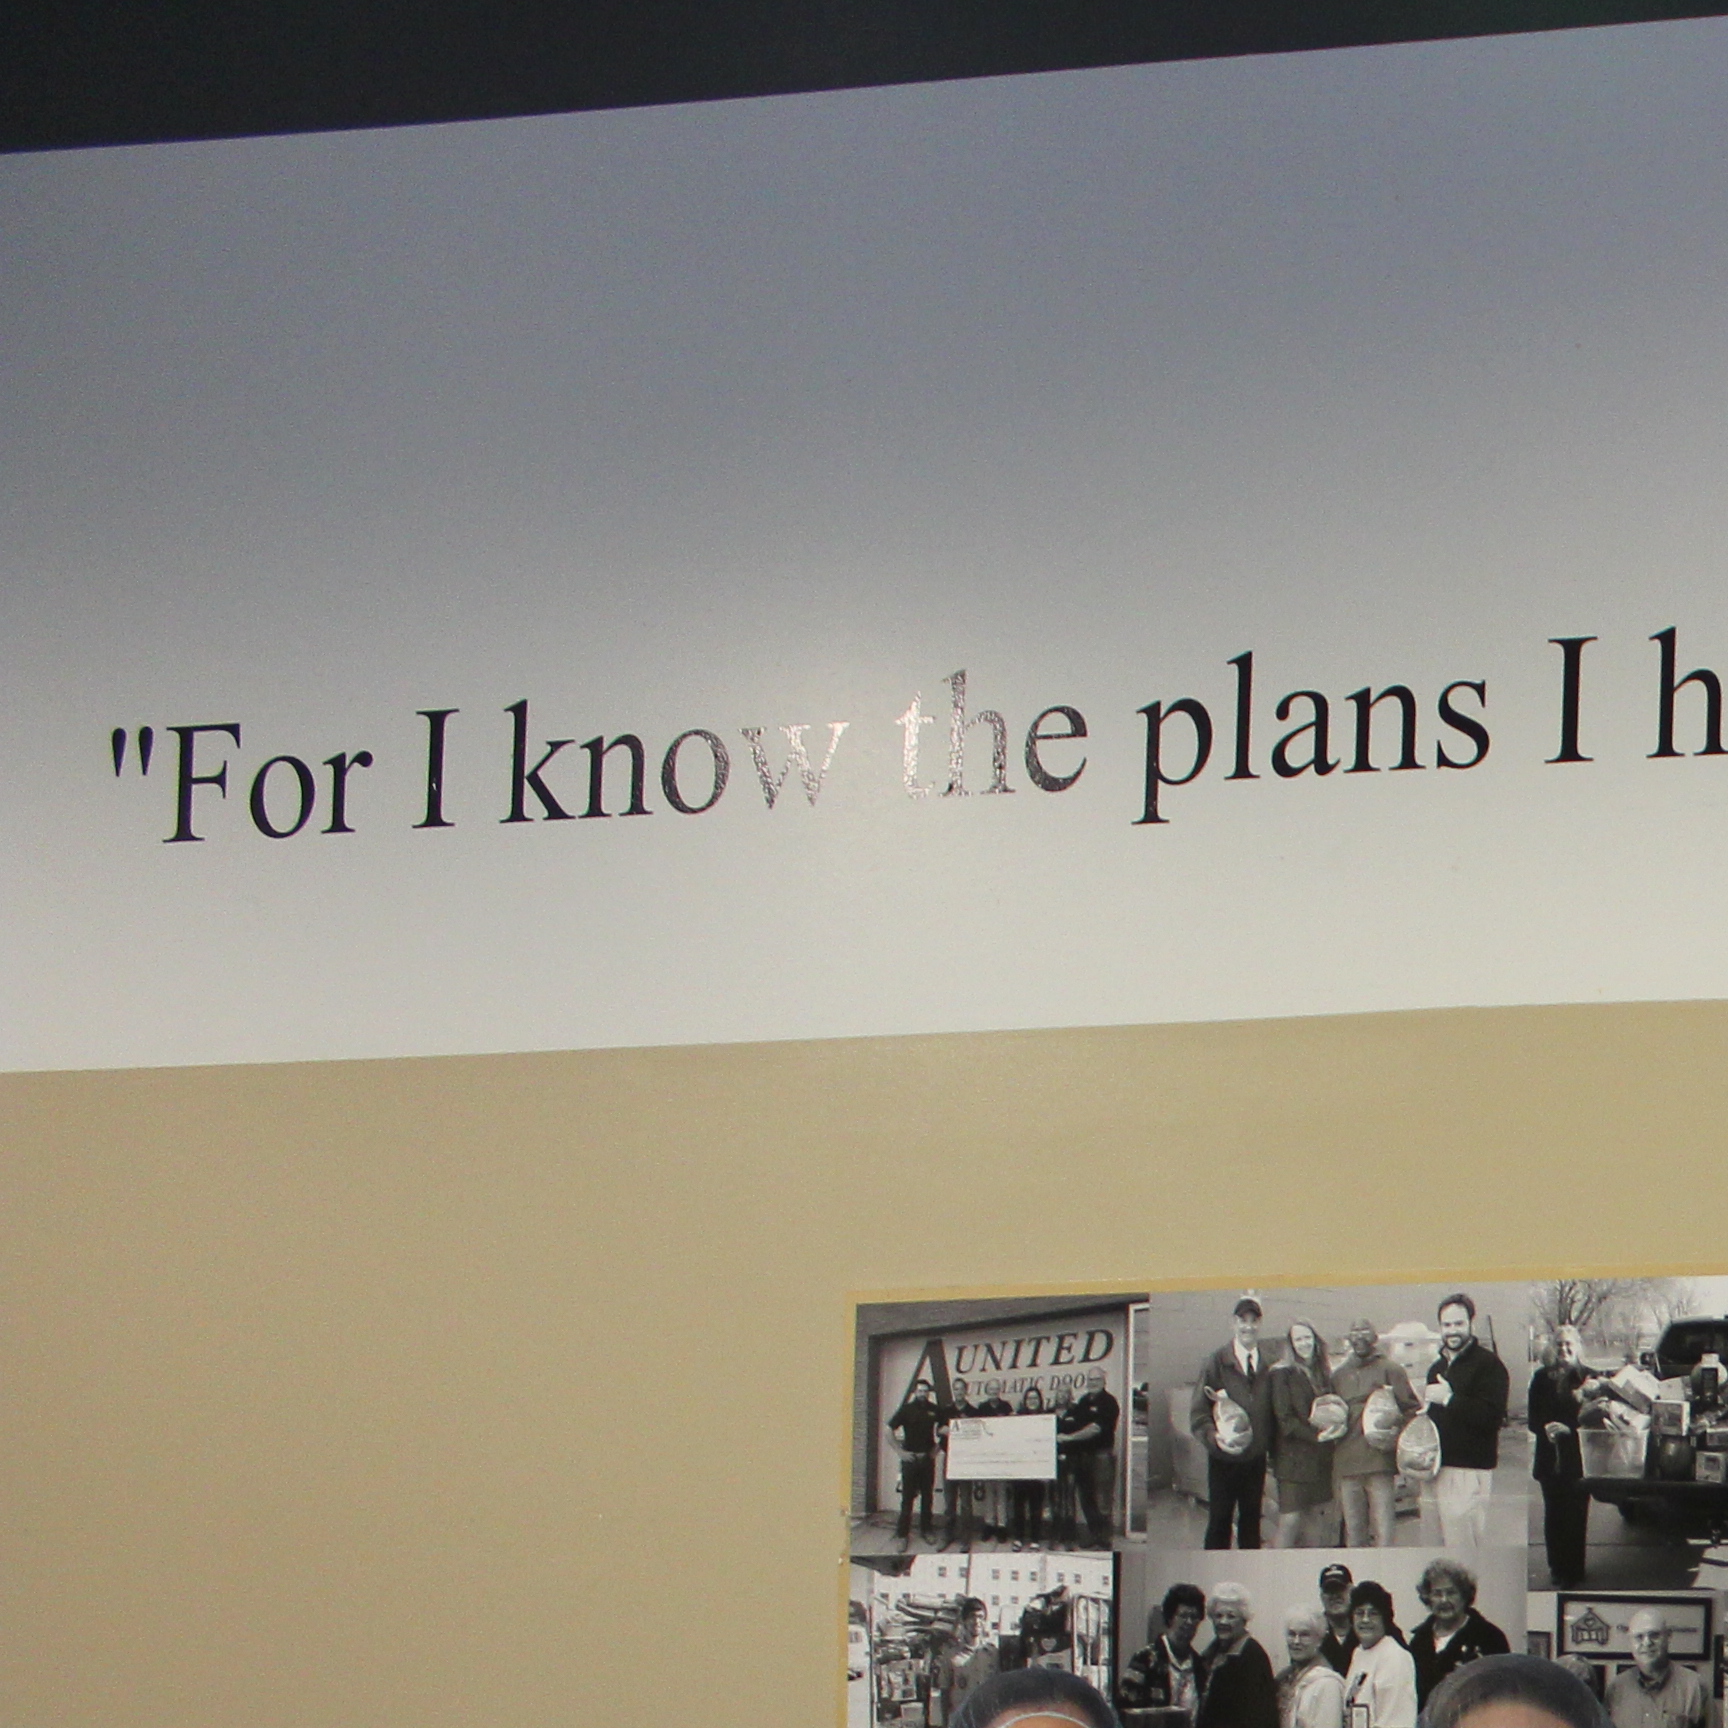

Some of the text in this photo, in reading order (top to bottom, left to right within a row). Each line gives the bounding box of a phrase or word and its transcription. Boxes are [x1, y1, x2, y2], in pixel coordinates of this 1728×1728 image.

[113, 723, 374, 844] "For
[413, 709, 460, 829] I
[500, 699, 850, 825] know
[894, 669, 1089, 805] the
[1133, 651, 1491, 826] plans
[1545, 636, 1600, 765] I
[954, 1328, 1114, 1375] UNITED
